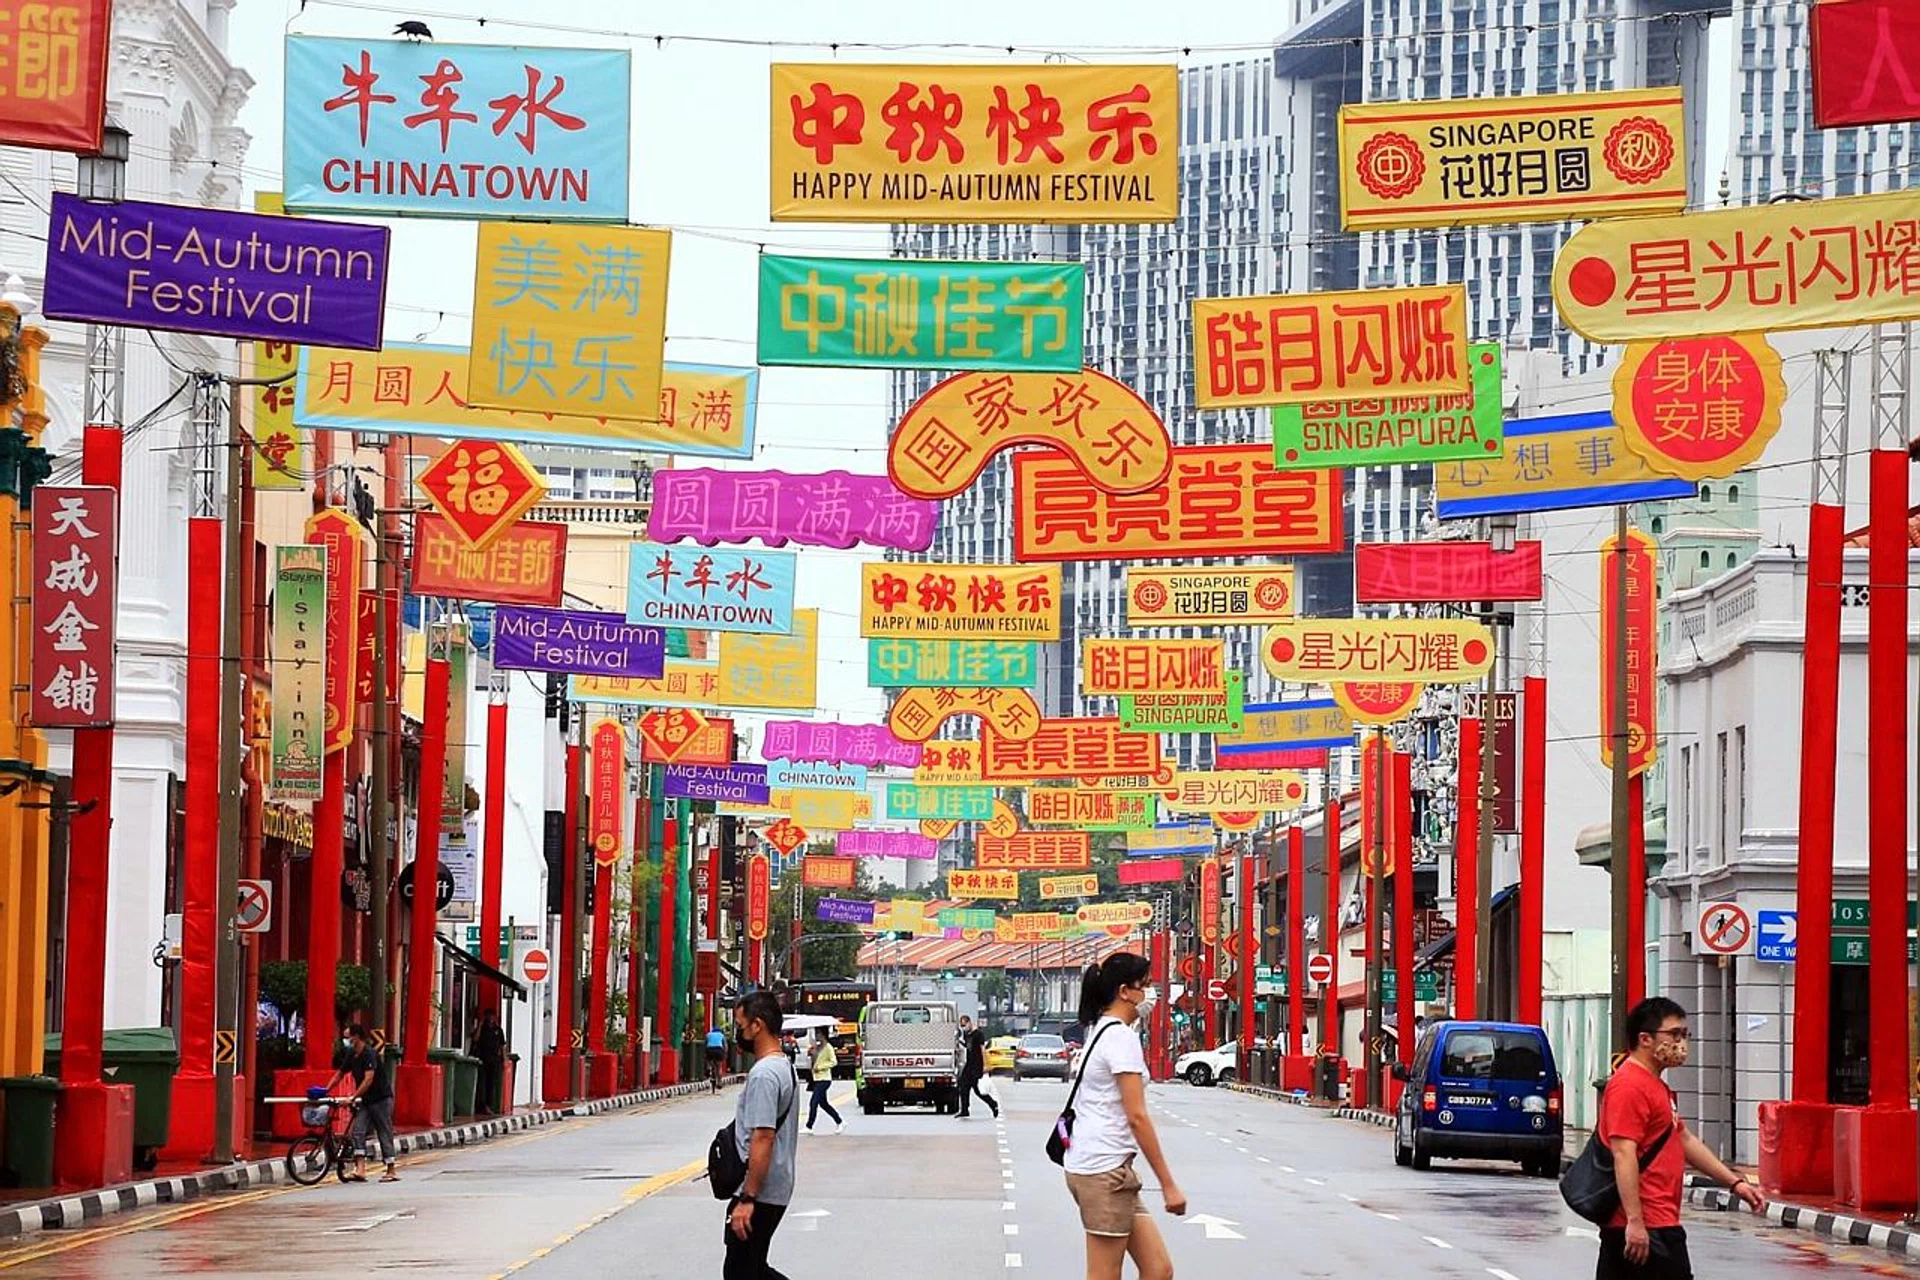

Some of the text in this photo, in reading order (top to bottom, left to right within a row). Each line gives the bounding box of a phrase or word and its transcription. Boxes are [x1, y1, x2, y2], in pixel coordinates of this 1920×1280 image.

[0, 3, 79, 100] 節
[323, 49, 587, 155] 牛车水
[790, 82, 1158, 165] 中秋快乐
[1429, 117, 1595, 148] SINGAPORE
[1372, 147, 1407, 186] 中
[1620, 135, 1658, 170] 秋
[322, 158, 588, 202] CHINATOWN
[793, 172, 1155, 202] HAPPY MID-AUTUMN FESTIVAL
[1440, 147, 1591, 200] 花好月圆
[60, 215, 373, 281] Mid-Autumn
[125, 269, 312, 325] Festival
[491, 237, 641, 318] 美满
[781, 270, 1069, 359] 中秋佳节
[490, 328, 640, 402] 快乐
[1207, 295, 1458, 396] 皓月闪烁
[1652, 349, 1742, 394] 身体
[903, 374, 1154, 484] 国家欢乐
[1303, 416, 1479, 451] SINGAPURA
[1652, 398, 1746, 442] 安康
[447, 449, 509, 516] 福
[1450, 436, 1647, 488] 心想事
[661, 475, 924, 542] 圆圆满满
[1034, 460, 1320, 545] 亮亮堂堂
[426, 532, 555, 586] 中秋佳節
[647, 550, 773, 601] 牛车水
[872, 573, 1052, 614] 中秋快乐
[1169, 576, 1251, 590] SINGAPORE
[1173, 591, 1249, 614] 花好月圆
[500, 614, 660, 647] Mid-Autumn
[644, 601, 773, 626] CHINATOWN
[872, 615, 1051, 632] HAPPY MID-AUTUMN FESTIVAL
[532, 642, 629, 670] Festival
[877, 640, 1028, 683] 中秋佳节
[1091, 646, 1220, 691] 皓月闪烁
[1298, 632, 1460, 673] 星光闪耀
[1134, 707, 1228, 725] SINGAPURA
[768, 722, 918, 763] 圆圆满满
[686, 781, 747, 799] Festival
[778, 771, 856, 786] CHINATOWN
[1182, 780, 1283, 805] 星光闪耀
[892, 786, 990, 815] 中秋佳节
[1032, 791, 1114, 820] 皓月闪烁
[950, 874, 1015, 888] 中秋快乐
[1760, 945, 1781, 956] ONE
[881, 1057, 935, 1066] NISSAN
